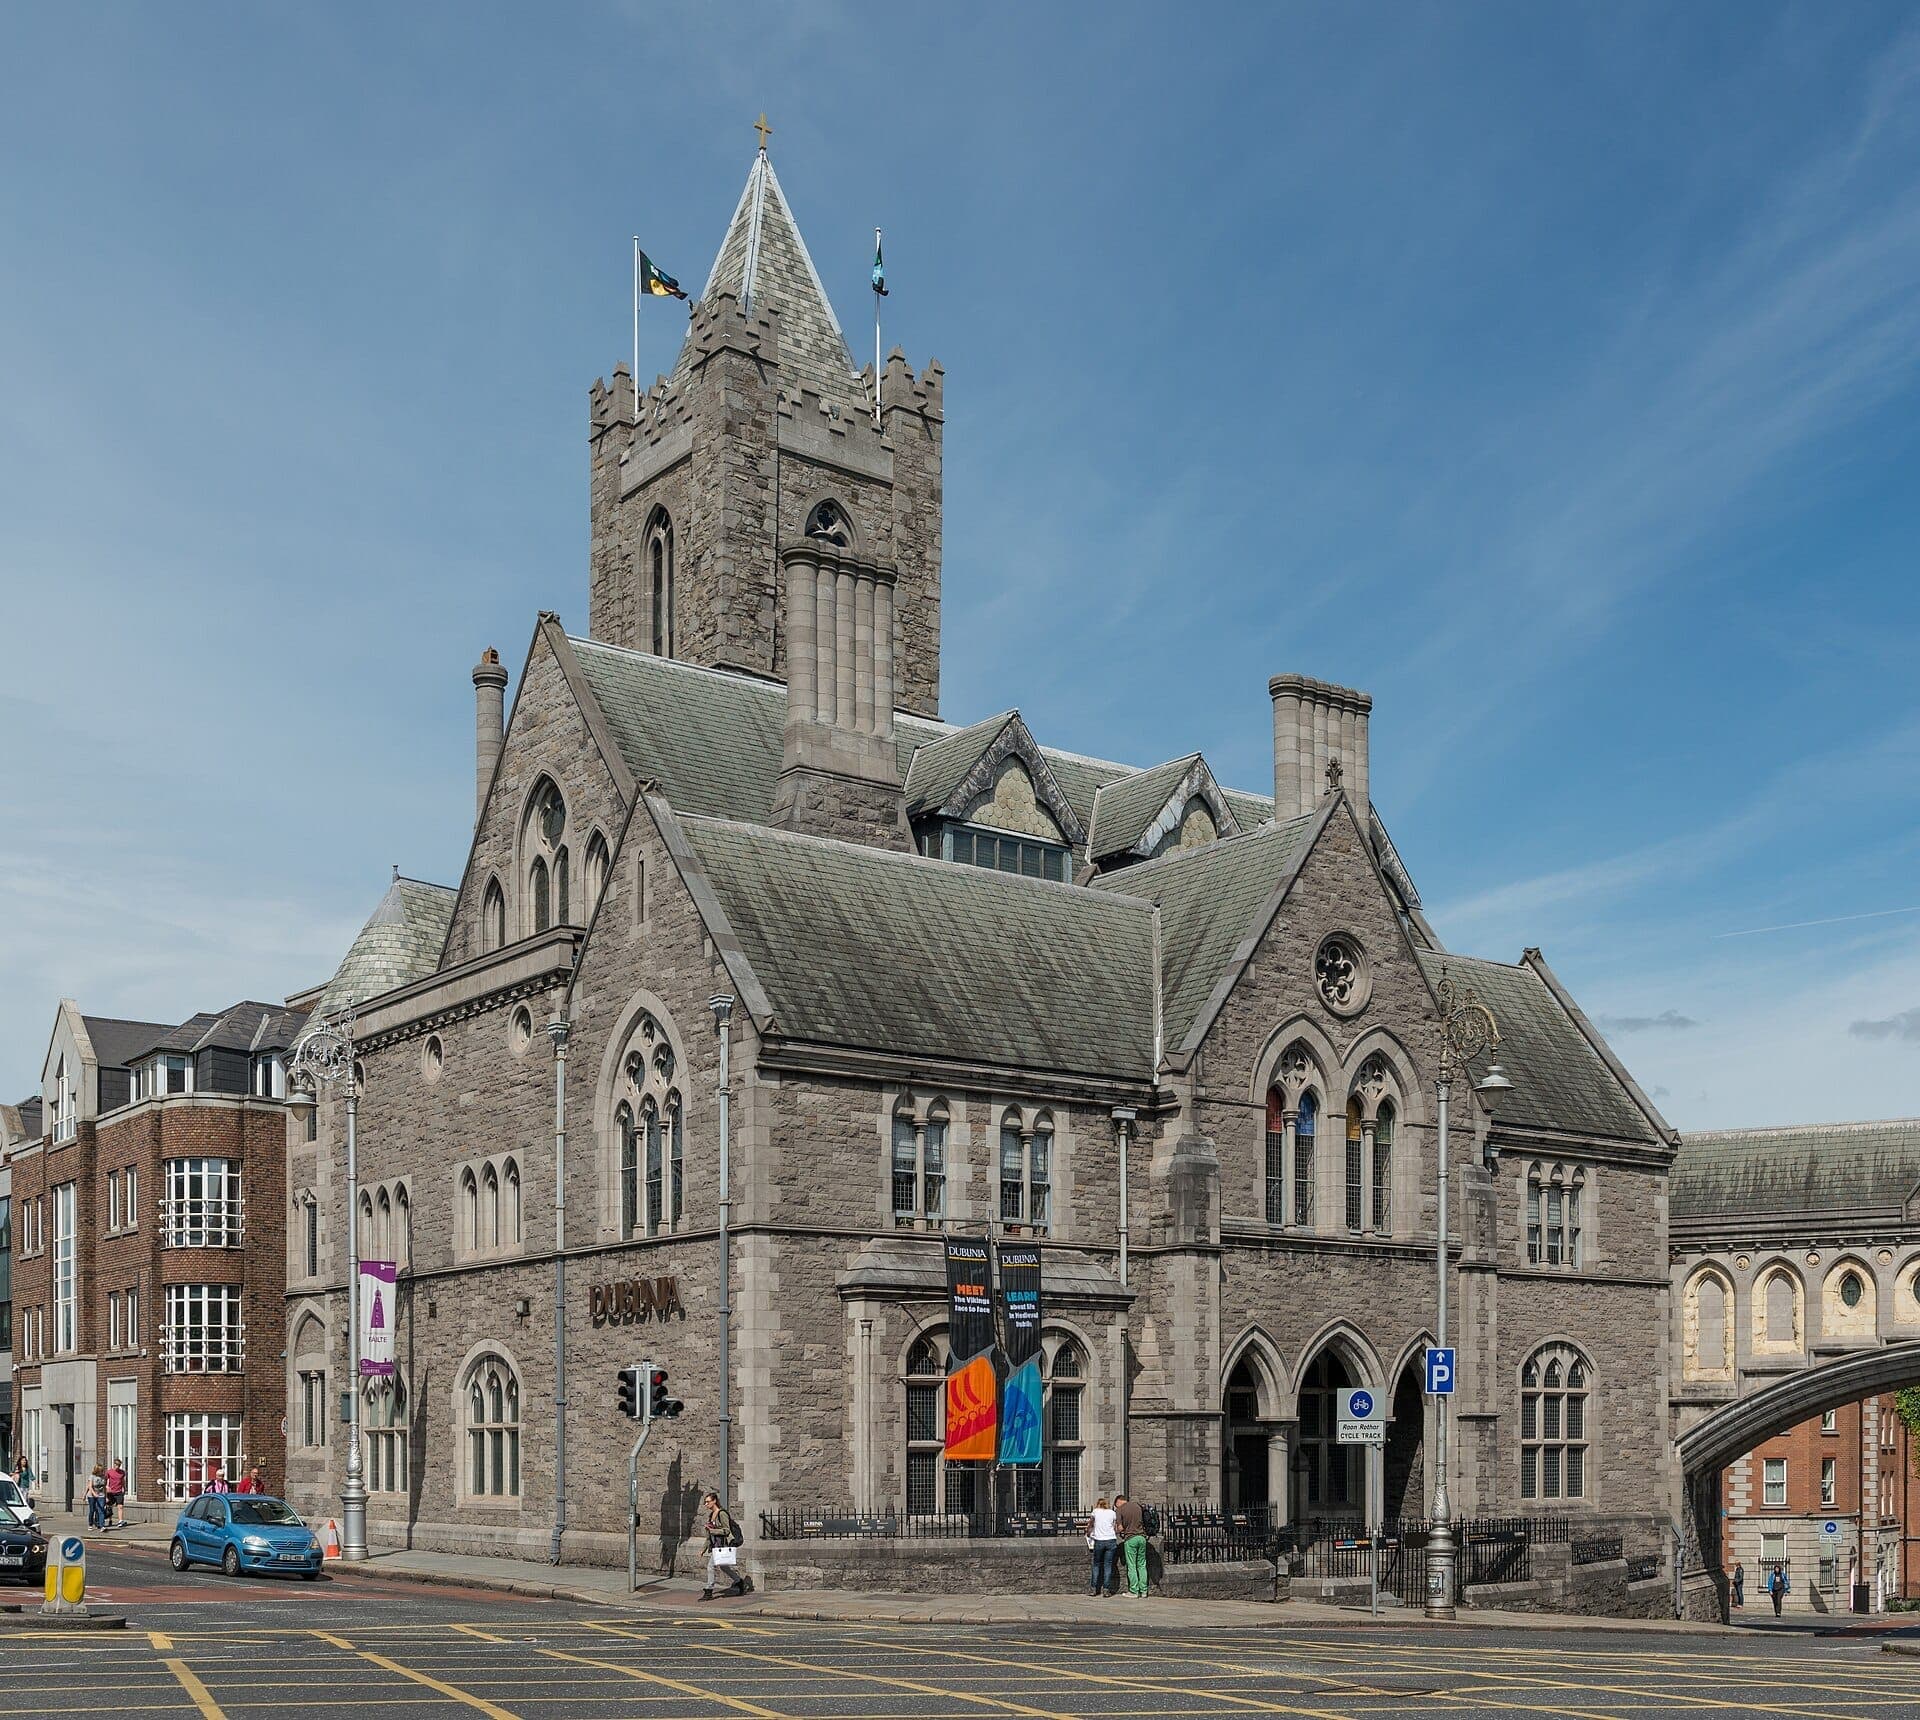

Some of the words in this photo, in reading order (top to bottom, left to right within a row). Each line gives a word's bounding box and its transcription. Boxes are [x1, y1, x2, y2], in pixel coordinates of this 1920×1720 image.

[956, 1284, 985, 1296] MEET
[966, 1297, 990, 1305] Vikings
[1006, 1291, 1038, 1302] LEARN
[1432, 1365, 1450, 1391] P
